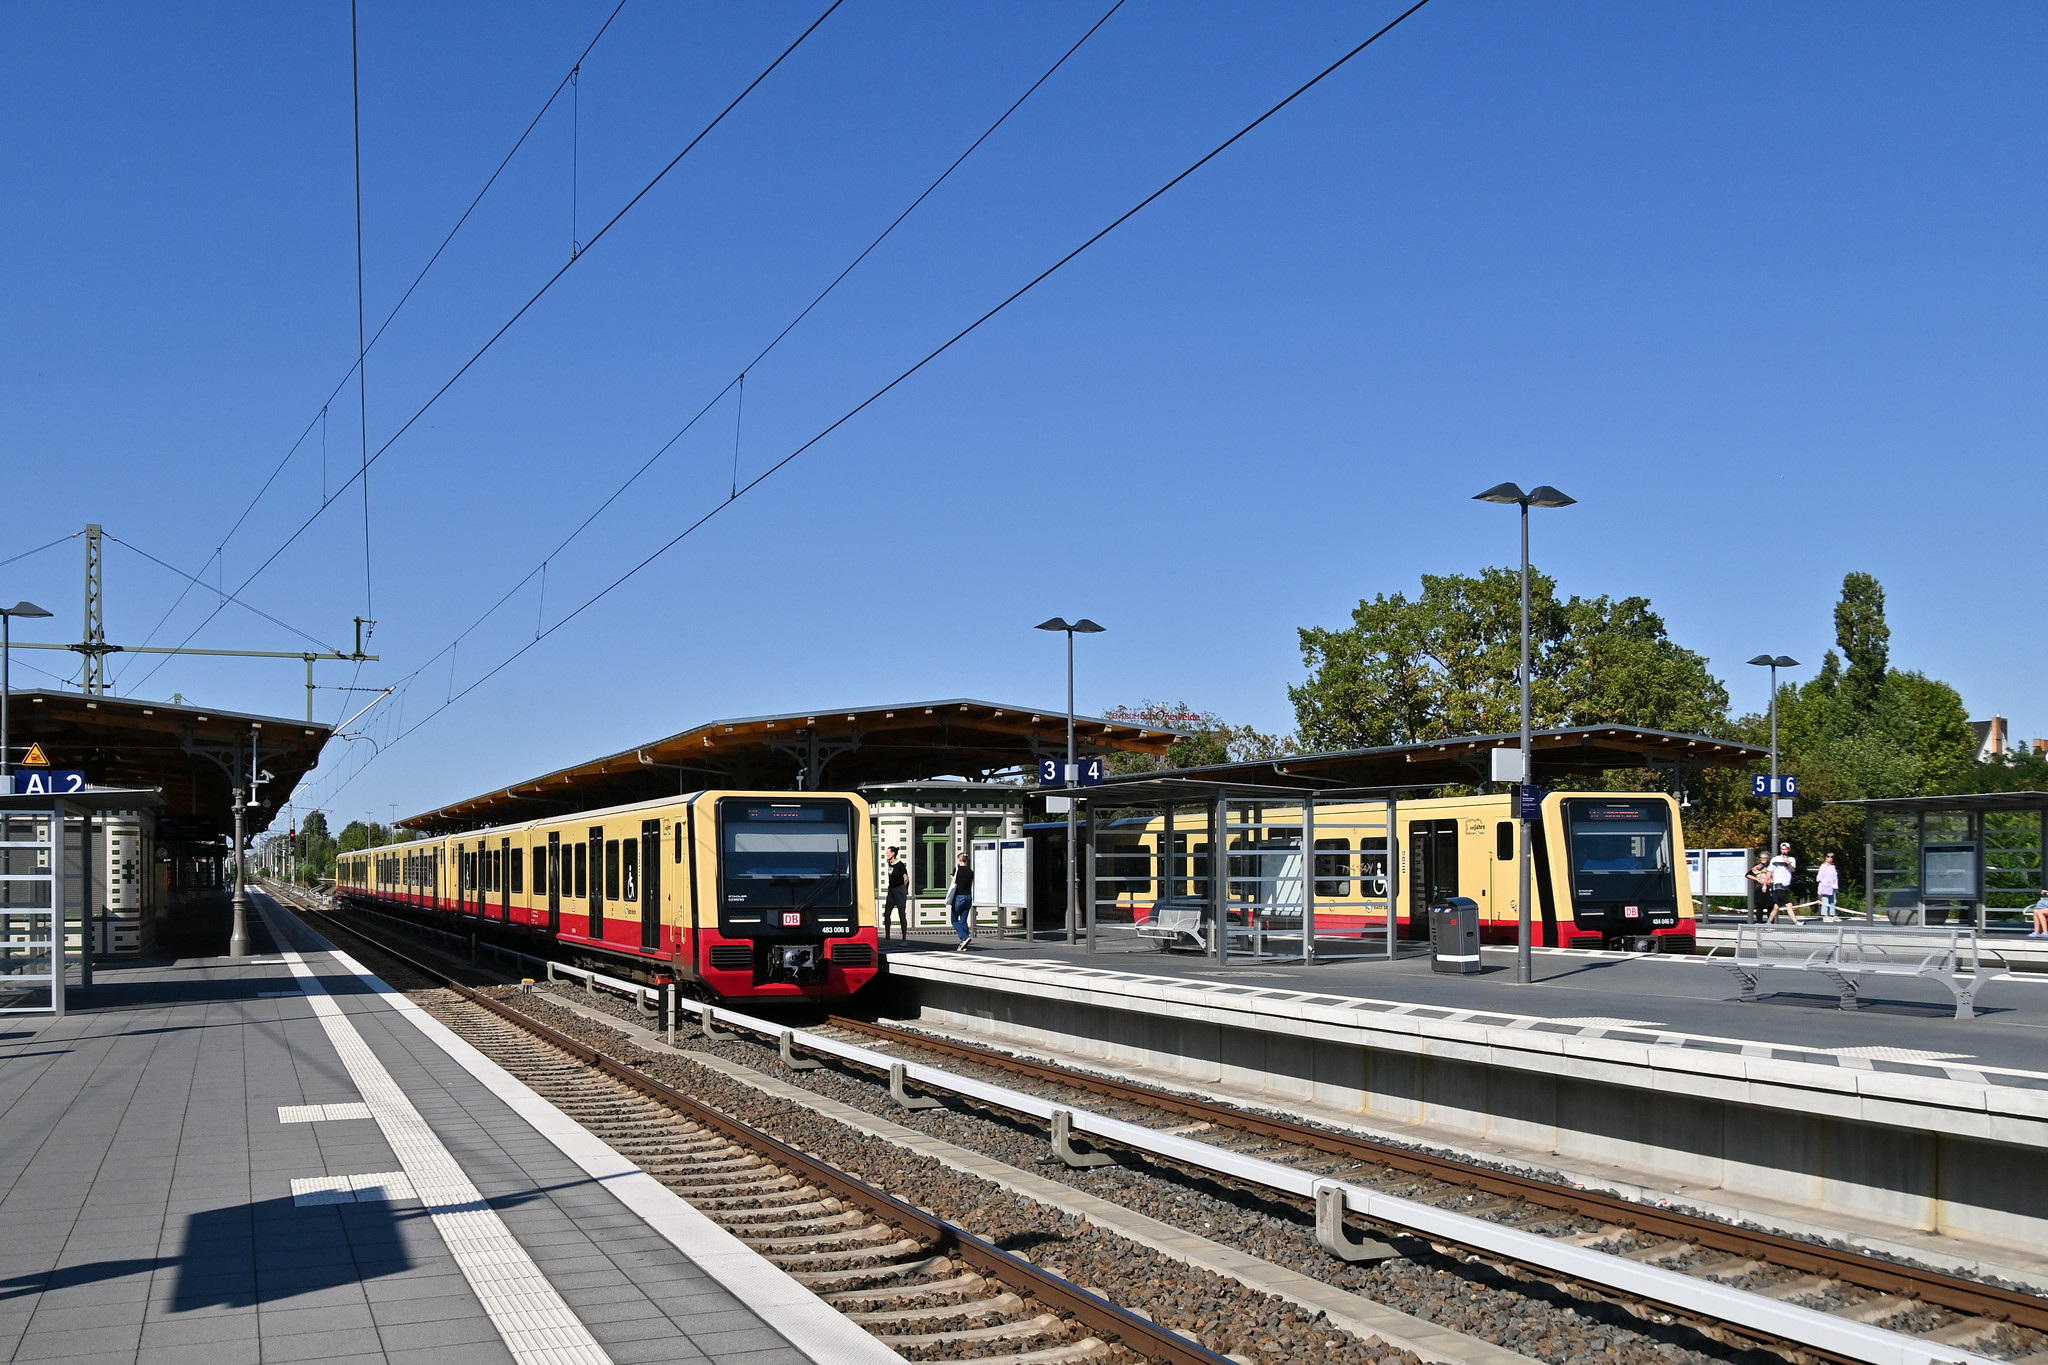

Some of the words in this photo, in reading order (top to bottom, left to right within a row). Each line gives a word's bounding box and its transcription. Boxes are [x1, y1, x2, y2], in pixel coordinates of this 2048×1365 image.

[1043, 760, 1056, 780] 3
[1087, 761, 1100, 780] 4
[25, 773, 45, 795] A
[66, 773, 82, 793] 2
[1755, 775, 1765, 792] 5
[1785, 776, 1795, 793] 6
[784, 914, 799, 924] DB
[1625, 907, 1637, 917] DB
